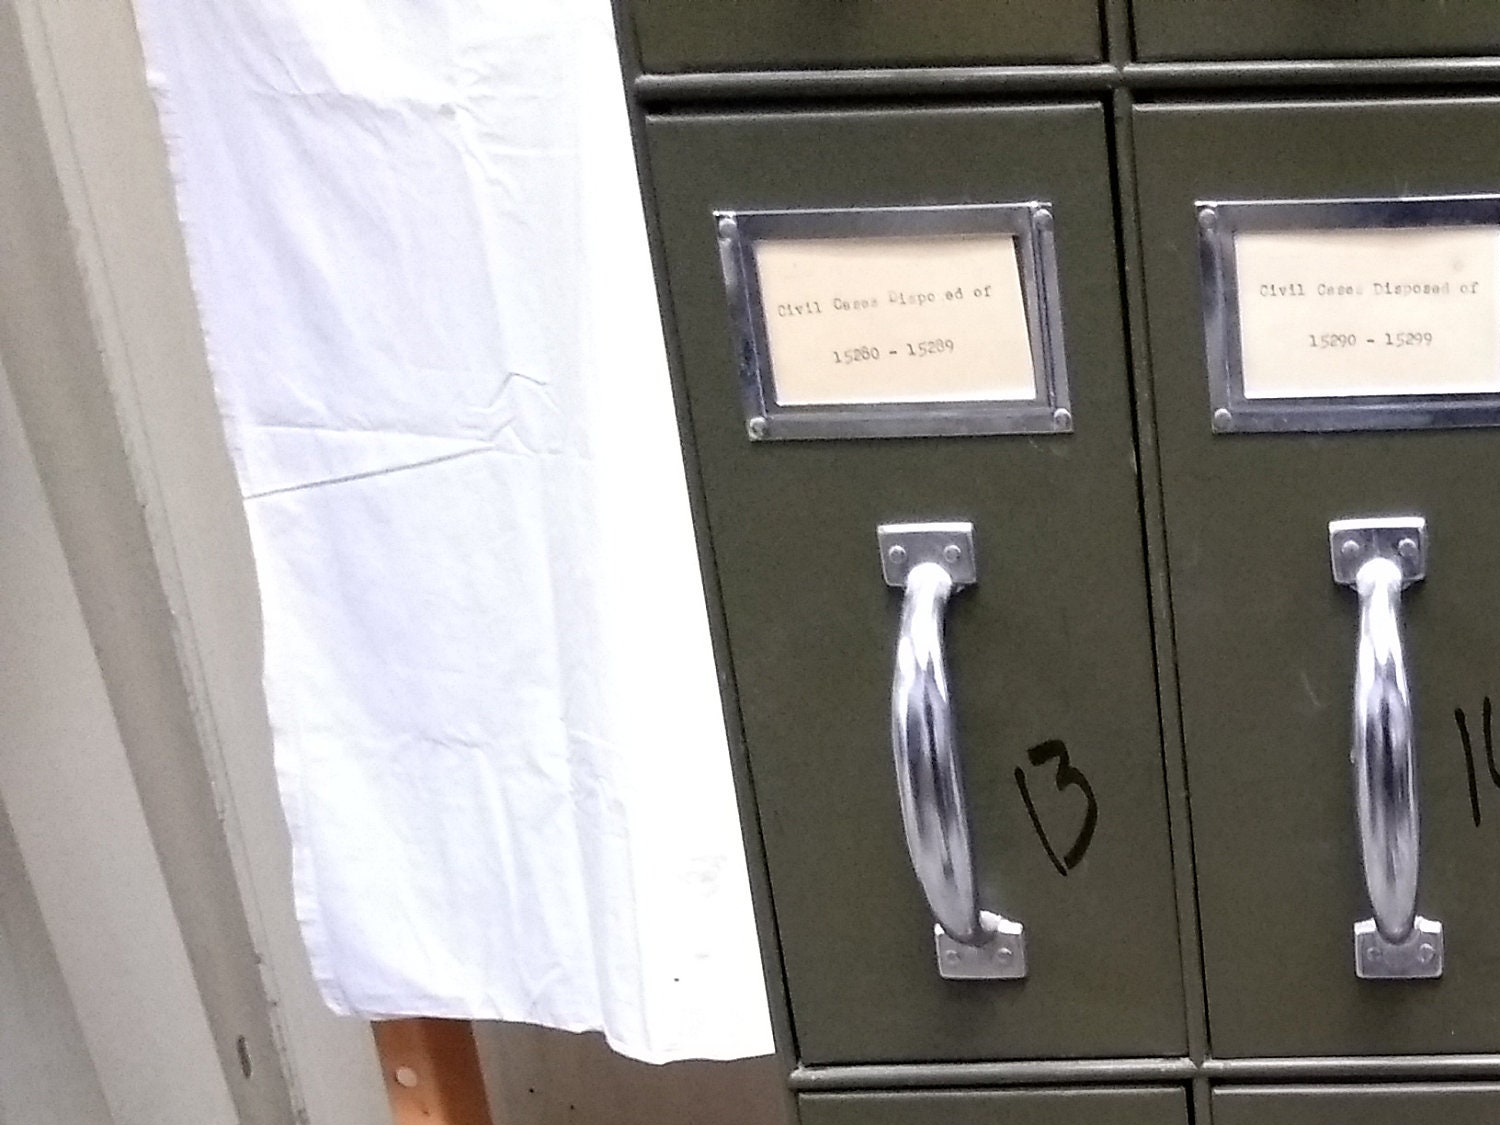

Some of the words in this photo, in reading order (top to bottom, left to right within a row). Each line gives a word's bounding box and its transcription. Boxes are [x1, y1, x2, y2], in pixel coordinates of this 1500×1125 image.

[778, 301, 823, 317] Civil
[833, 298, 879, 312] Cases
[889, 286, 963, 305] Dispoed
[974, 285, 991, 298] of
[1260, 283, 1305, 297] Civil
[1317, 283, 1363, 296] Cases
[1372, 282, 1449, 297] Disposed
[1460, 281, 1479, 295] of
[833, 347, 880, 363] 15280
[907, 339, 954, 358] 15289
[1309, 333, 1357, 349] 15290
[1385, 332, 1433, 348] 15299
[1014, 739, 1098, 877] 13
